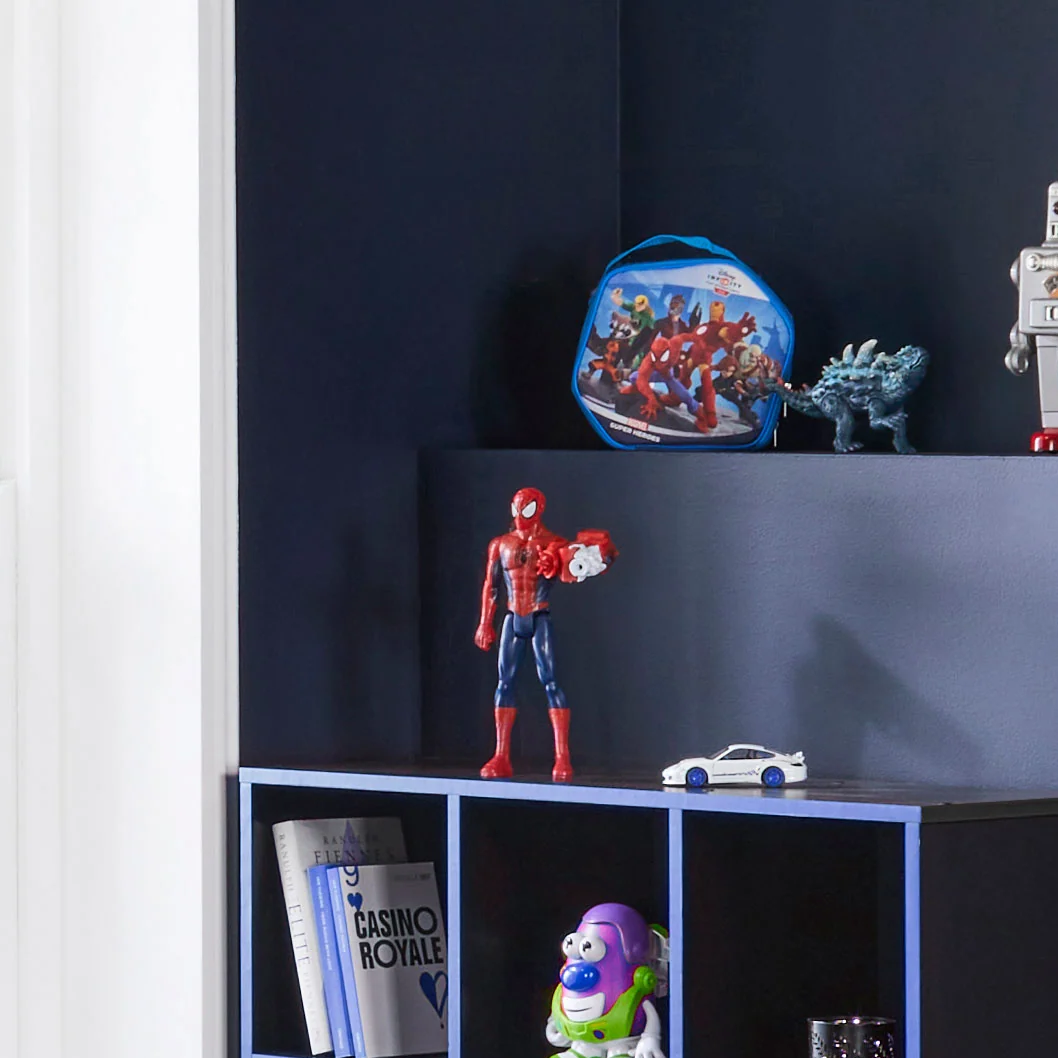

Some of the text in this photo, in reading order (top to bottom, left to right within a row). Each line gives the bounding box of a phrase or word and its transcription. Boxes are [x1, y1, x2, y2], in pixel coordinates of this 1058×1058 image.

[288, 904, 311, 966] ELITE
[354, 906, 438, 939] CASINO
[358, 936, 444, 970] ROYALE
